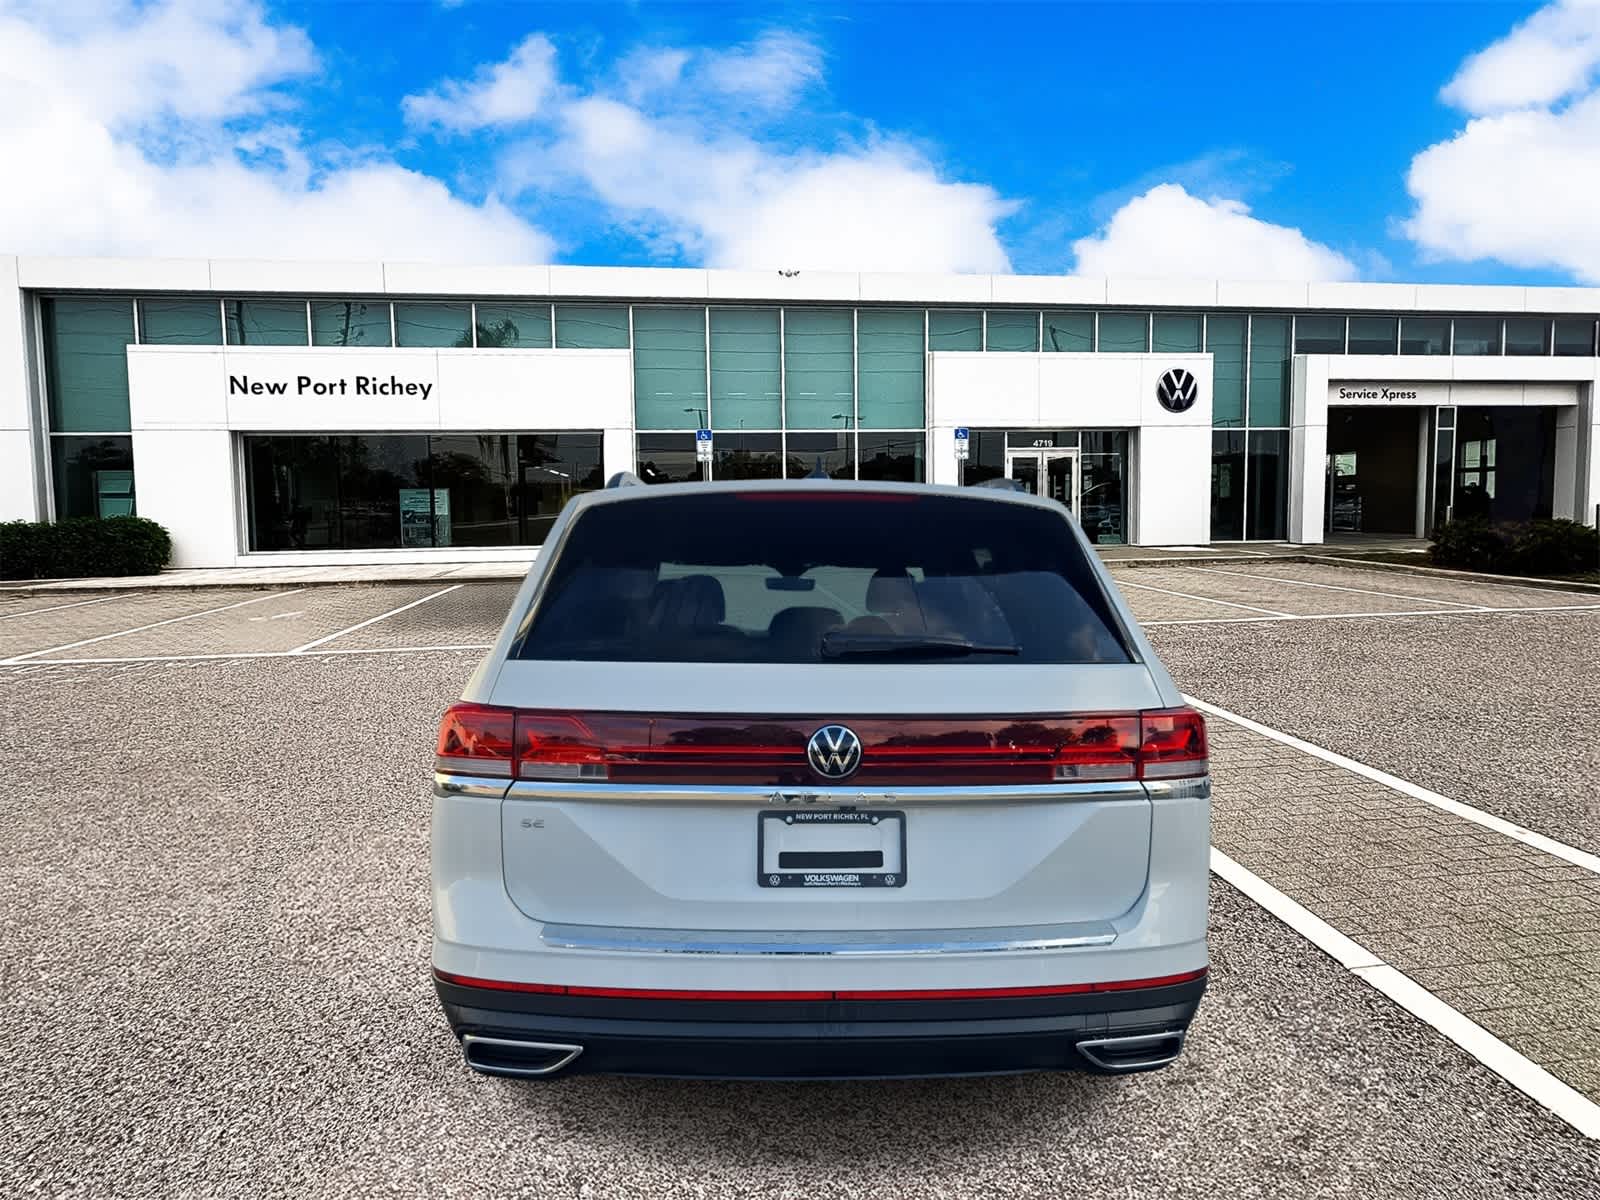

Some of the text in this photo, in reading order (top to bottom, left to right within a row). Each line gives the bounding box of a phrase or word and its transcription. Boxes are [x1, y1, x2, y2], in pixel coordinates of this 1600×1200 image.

[229, 375, 433, 401] New Port Richey
[1339, 387, 1417, 402] Service Xpress
[1032, 439, 1054, 448] 4719
[804, 874, 860, 882] VOLKSWAGEN
